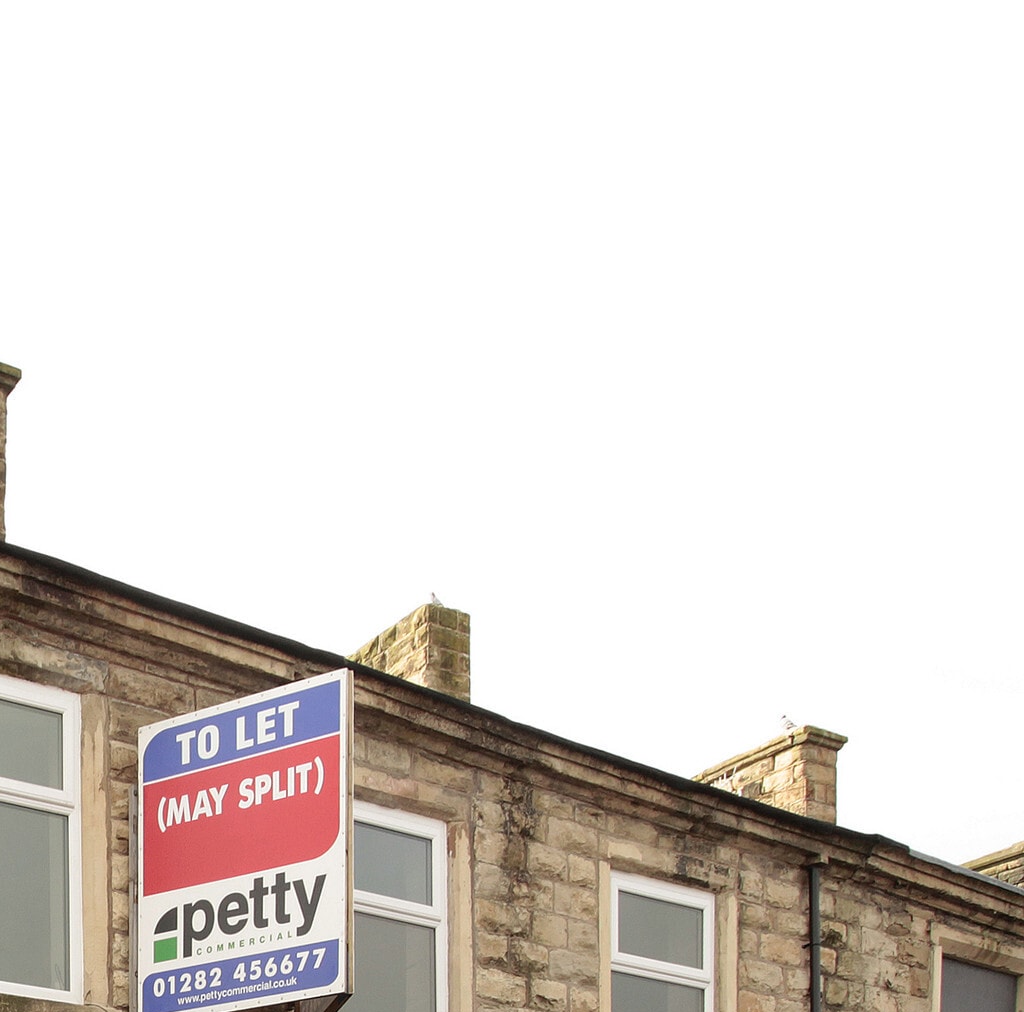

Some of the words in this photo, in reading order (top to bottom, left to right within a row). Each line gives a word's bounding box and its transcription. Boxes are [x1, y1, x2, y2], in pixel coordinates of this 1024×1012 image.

[176, 724, 220, 765] TO
[236, 701, 300, 751] LET
[157, 784, 230, 833] (MAY
[238, 755, 325, 809] SPLIT)
[183, 872, 328, 958] petty
[196, 930, 294, 957] COMMERCIAL
[153, 967, 223, 997] 01282
[233, 948, 327, 982] 456677
[177, 976, 298, 1005] www.pettycommercial.co.uk
